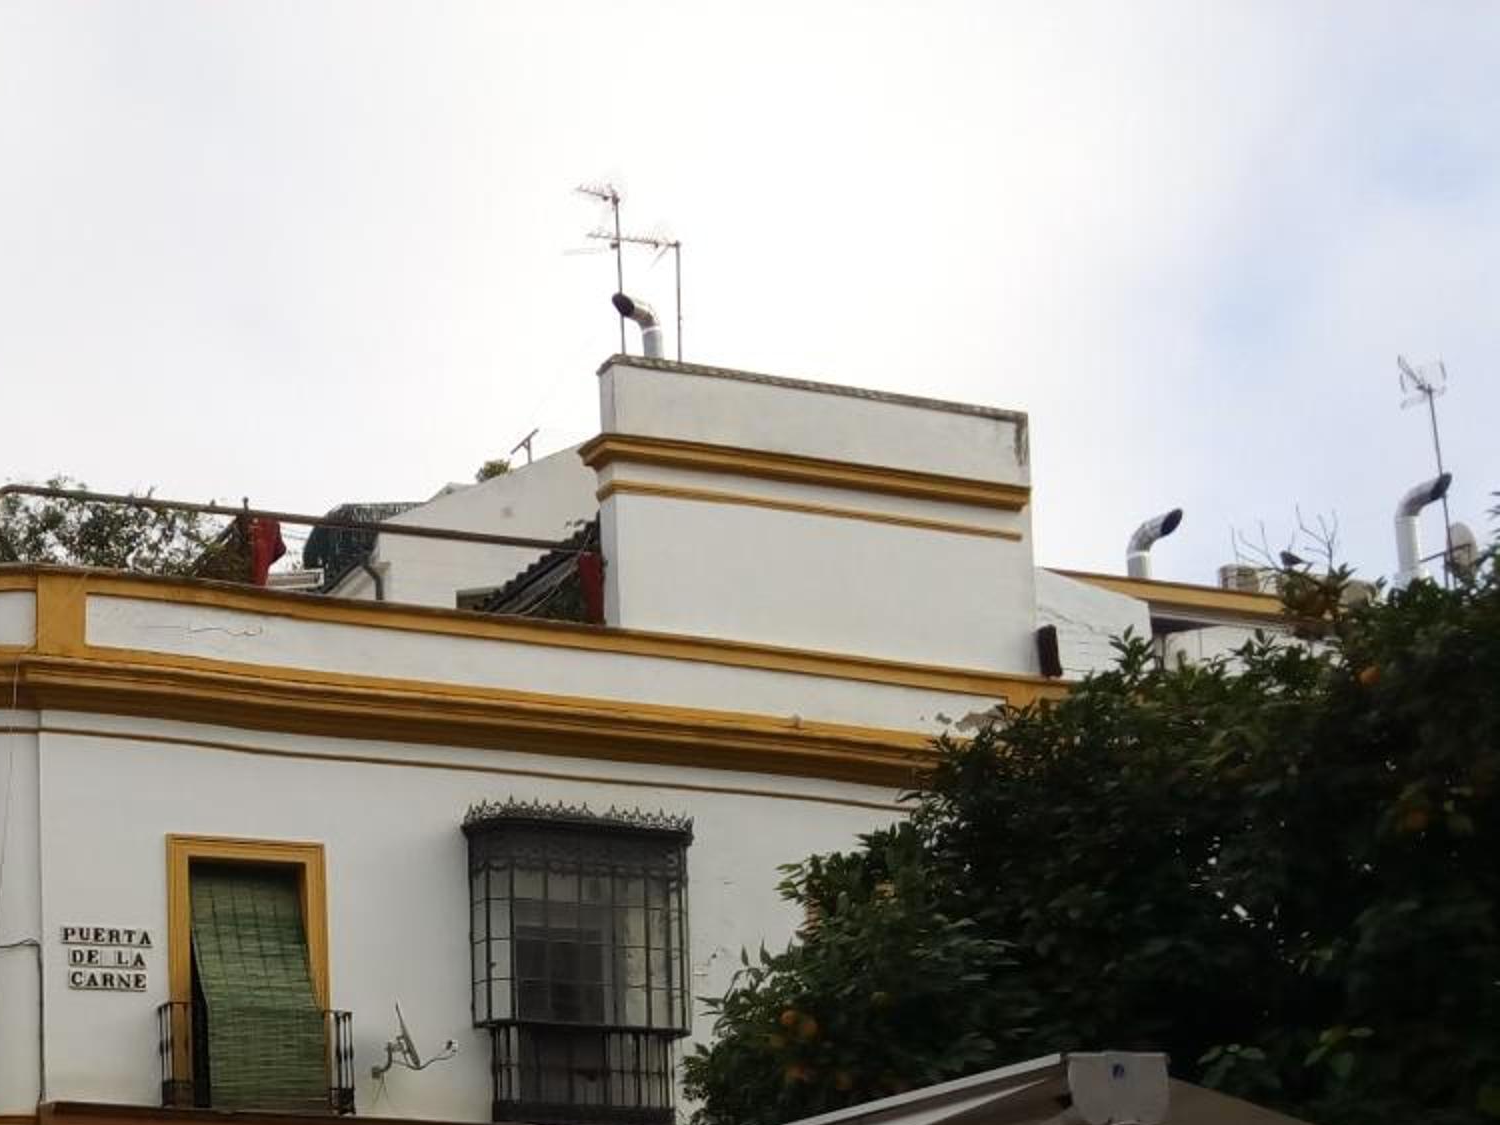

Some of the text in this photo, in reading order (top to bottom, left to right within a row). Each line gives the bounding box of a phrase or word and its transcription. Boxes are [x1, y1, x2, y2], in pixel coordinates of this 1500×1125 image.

[62, 927, 152, 945] PUERTA
[71, 949, 146, 967] DE LA
[70, 971, 147, 989] CARNE
